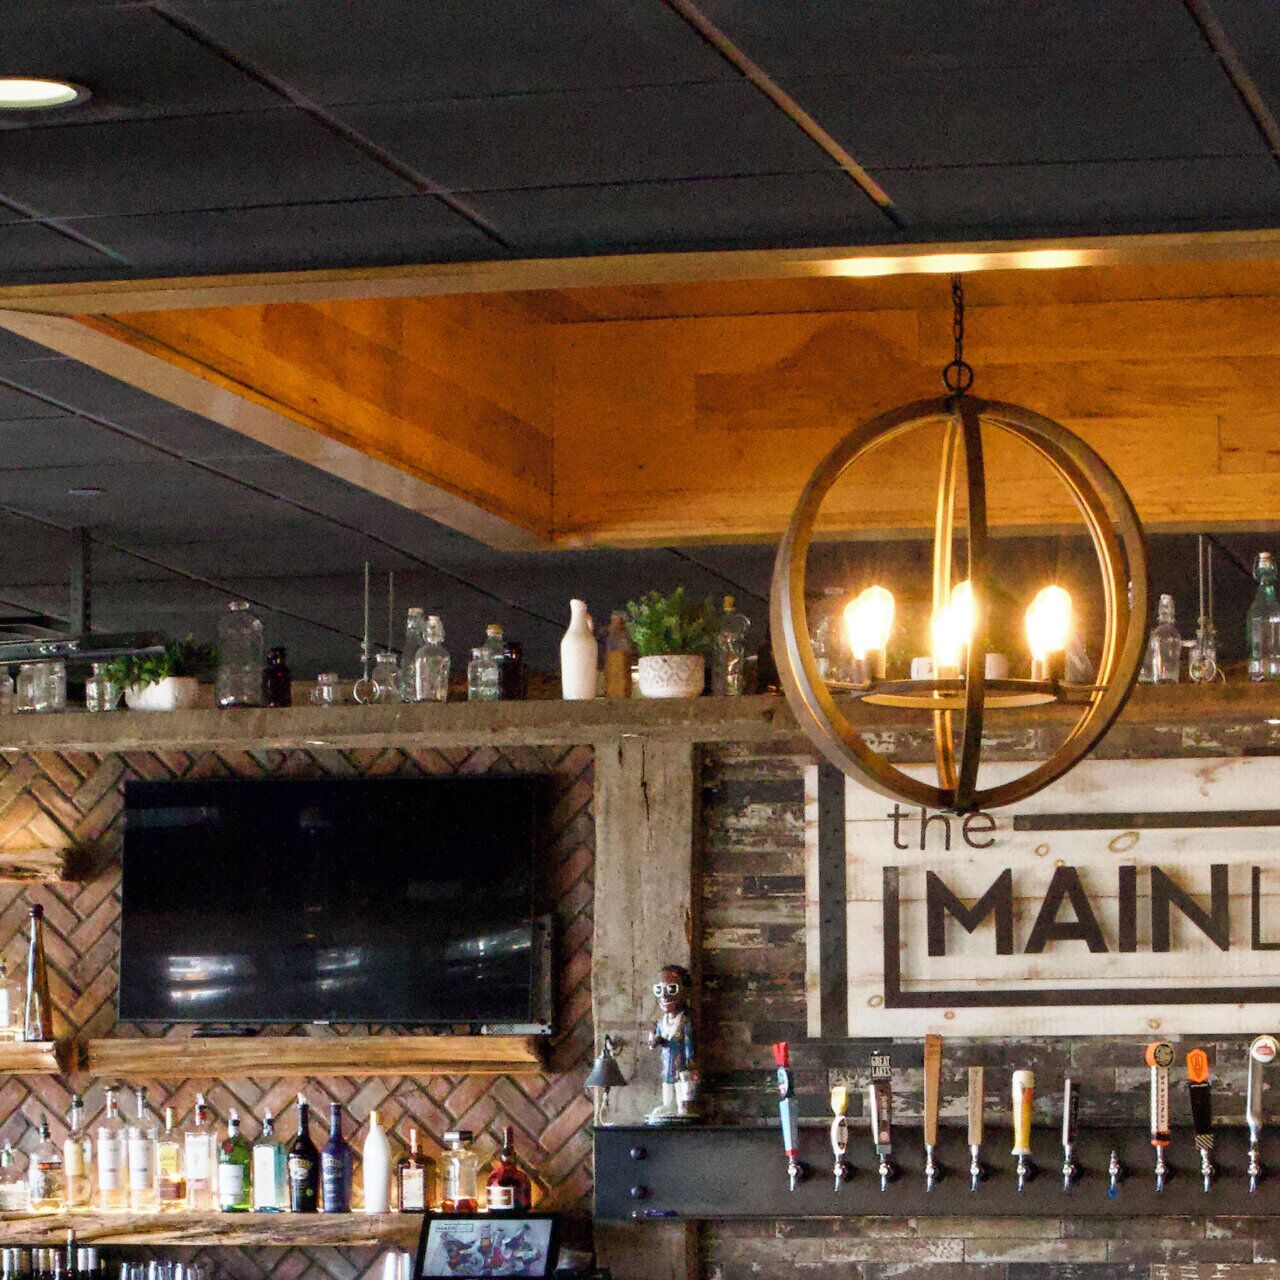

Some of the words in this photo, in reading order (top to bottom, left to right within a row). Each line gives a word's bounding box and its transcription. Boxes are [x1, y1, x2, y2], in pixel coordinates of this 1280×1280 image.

[887, 803, 997, 851] the
[870, 1055, 891, 1067] GREAT
[872, 1066, 892, 1077] LAKES
